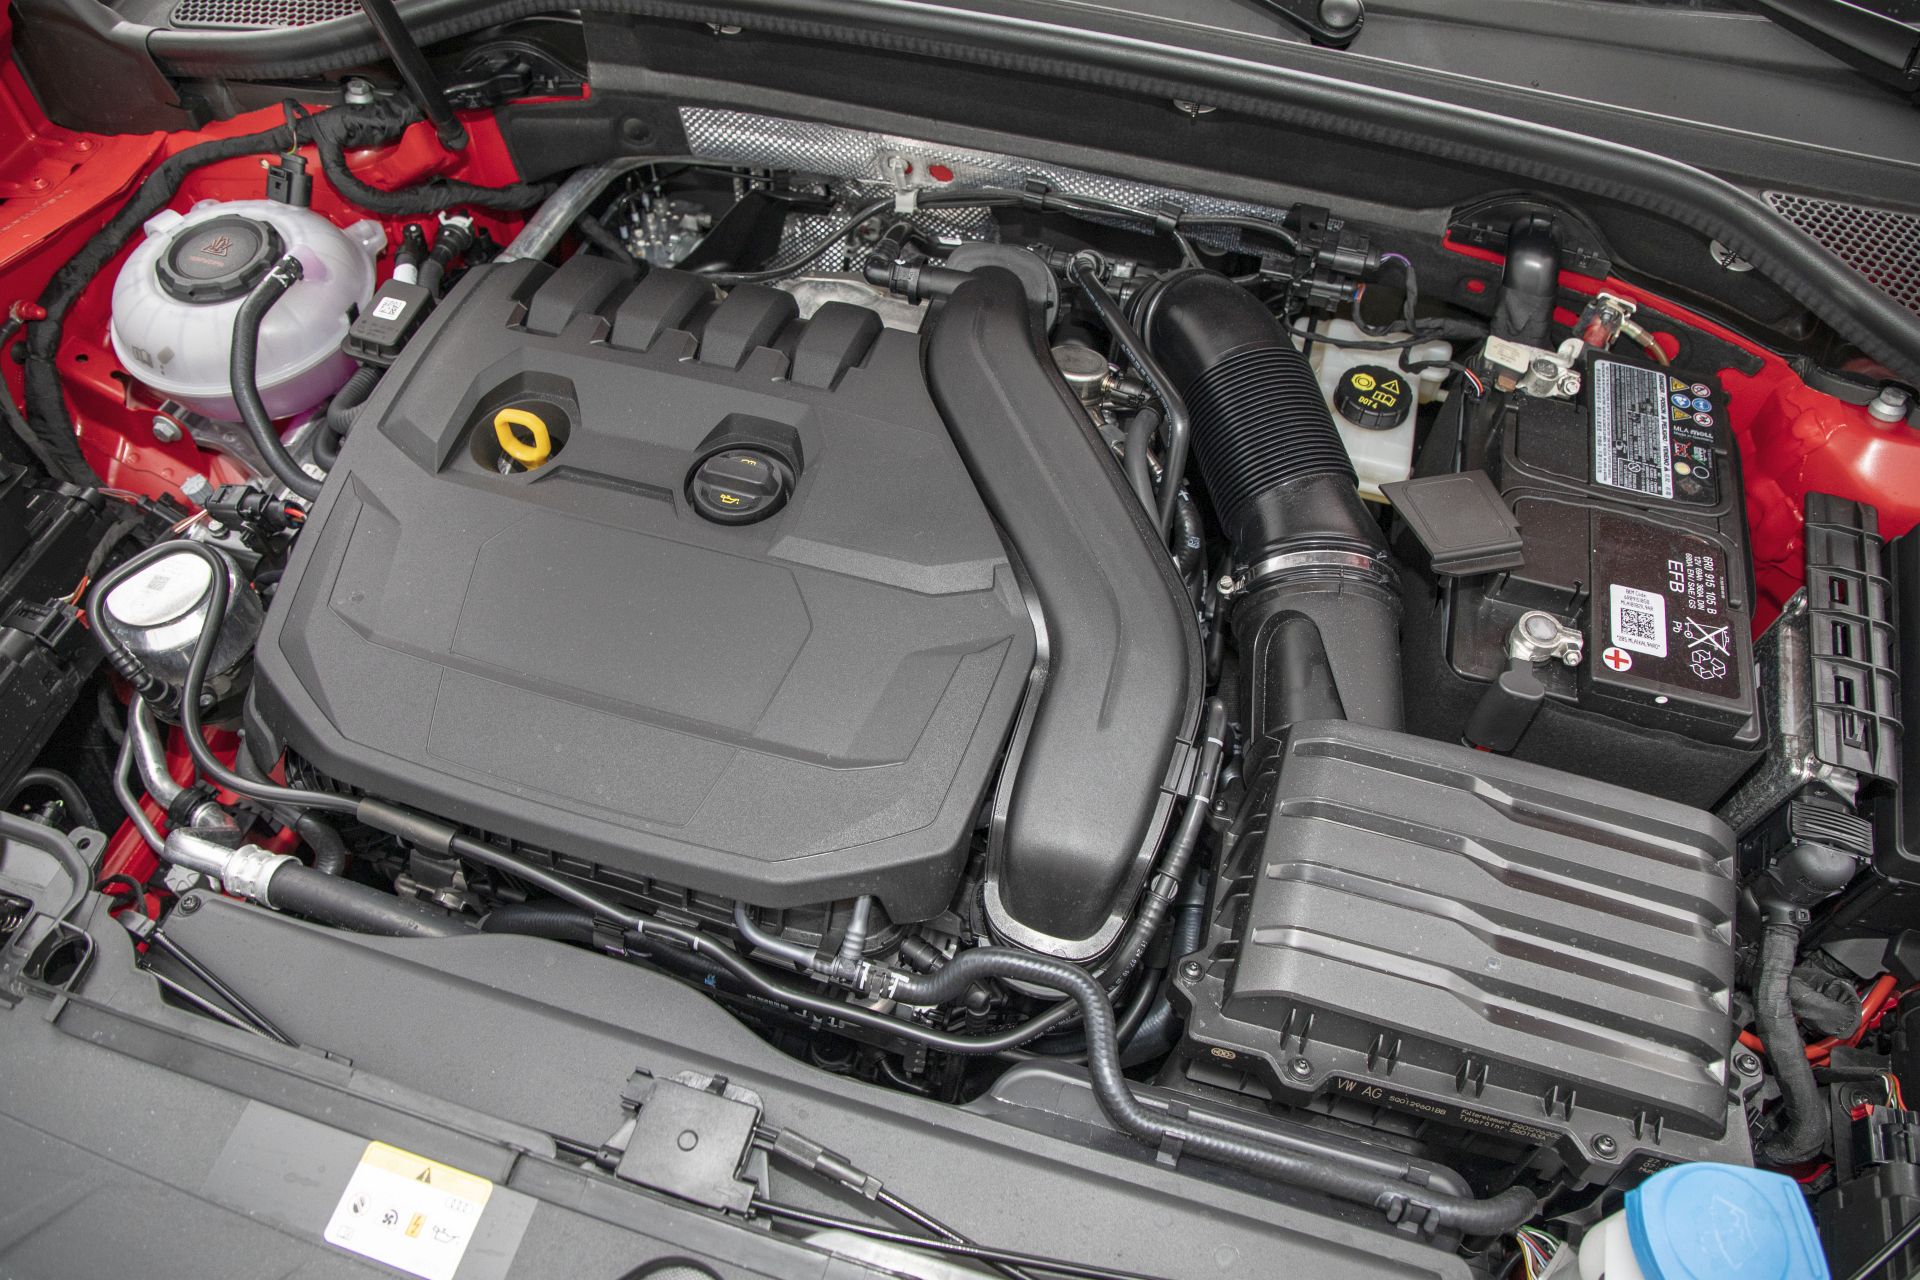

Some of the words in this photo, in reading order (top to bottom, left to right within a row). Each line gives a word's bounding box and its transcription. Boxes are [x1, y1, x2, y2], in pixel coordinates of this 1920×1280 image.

[1358, 395, 1373, 406] DOT
[1673, 425, 1689, 433] MLA
[1694, 556, 1702, 567] 12V
[1702, 556, 1714, 571] 6R0
[1667, 559, 1684, 593] EFB
[1704, 573, 1716, 588] 915
[1705, 591, 1717, 605] 105
[1697, 599, 1705, 611] DIN
[1672, 620, 1683, 633] Pb
[1337, 1078, 1357, 1092] VW
[1361, 1085, 1382, 1099] AG
